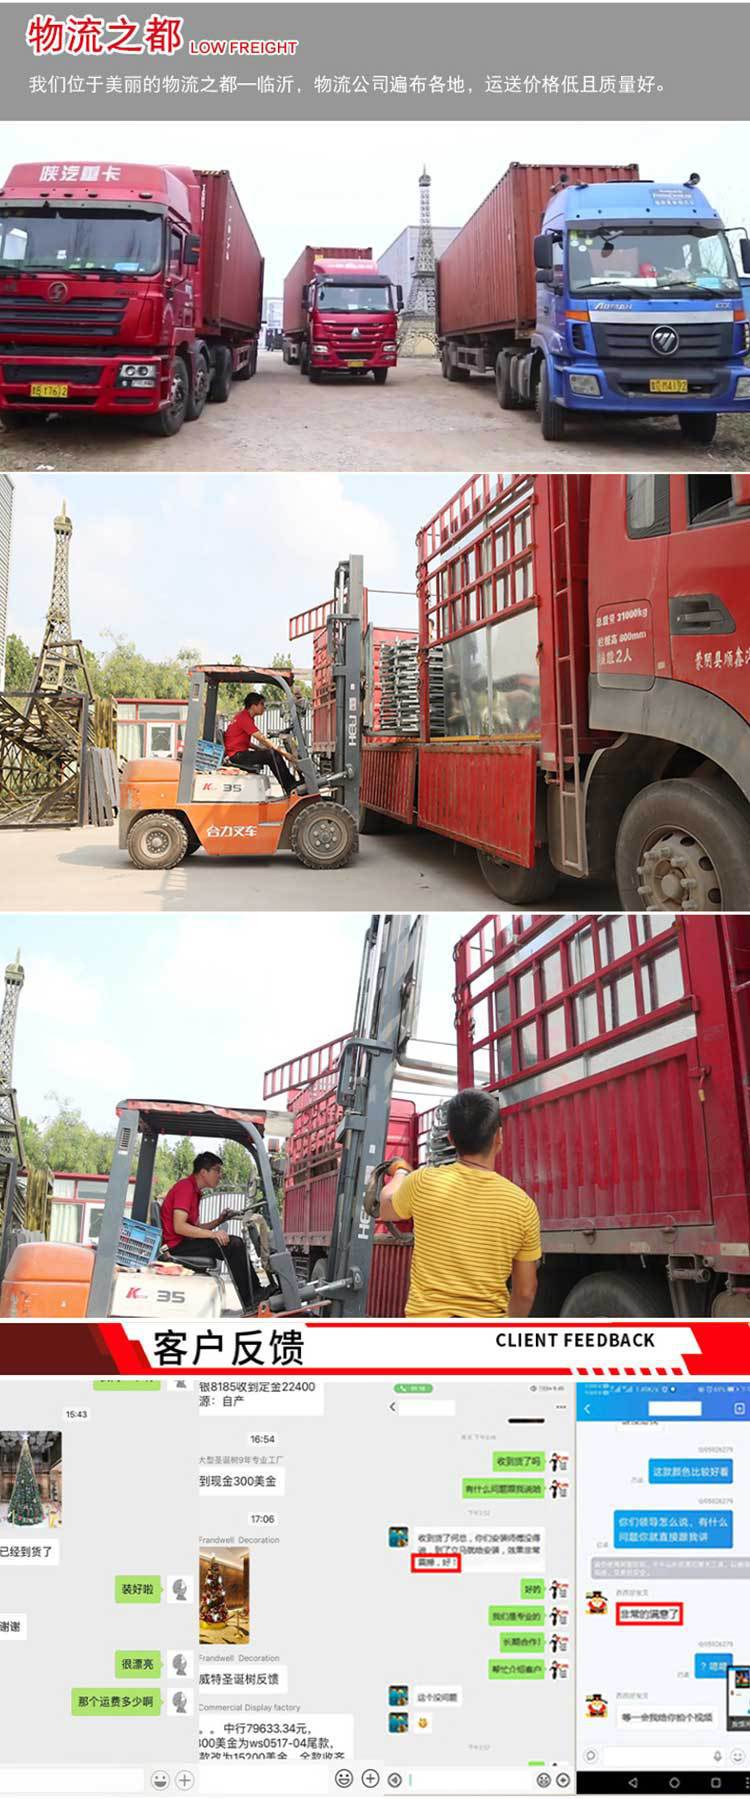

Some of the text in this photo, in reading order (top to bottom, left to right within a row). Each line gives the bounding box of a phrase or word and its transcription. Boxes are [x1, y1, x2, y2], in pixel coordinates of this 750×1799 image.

[39, 164, 121, 182] 陕汽重卡
[223, 784, 242, 792] 35
[206, 825, 257, 837] 合力叉车
[156, 1290, 185, 1303] 35
[66, 1410, 87, 1418] 15:43
[250, 1435, 275, 1443] 16:54
[200, 1475, 276, 1487] 到现金300美金
[251, 1515, 275, 1523] 17:06
[238, 1536, 280, 1544] Decoration
[122, 1584, 154, 1595] 装好啦
[0, 1621, 20, 1632] 谢谢
[238, 1654, 280, 1662] Decoration
[122, 1659, 154, 1670] 很漂亮
[199, 1673, 279, 1685] 威特圣诞树反馈
[78, 1696, 154, 1708] 那个运费多少啊
[198, 1704, 301, 1713] Commercial Display factory
